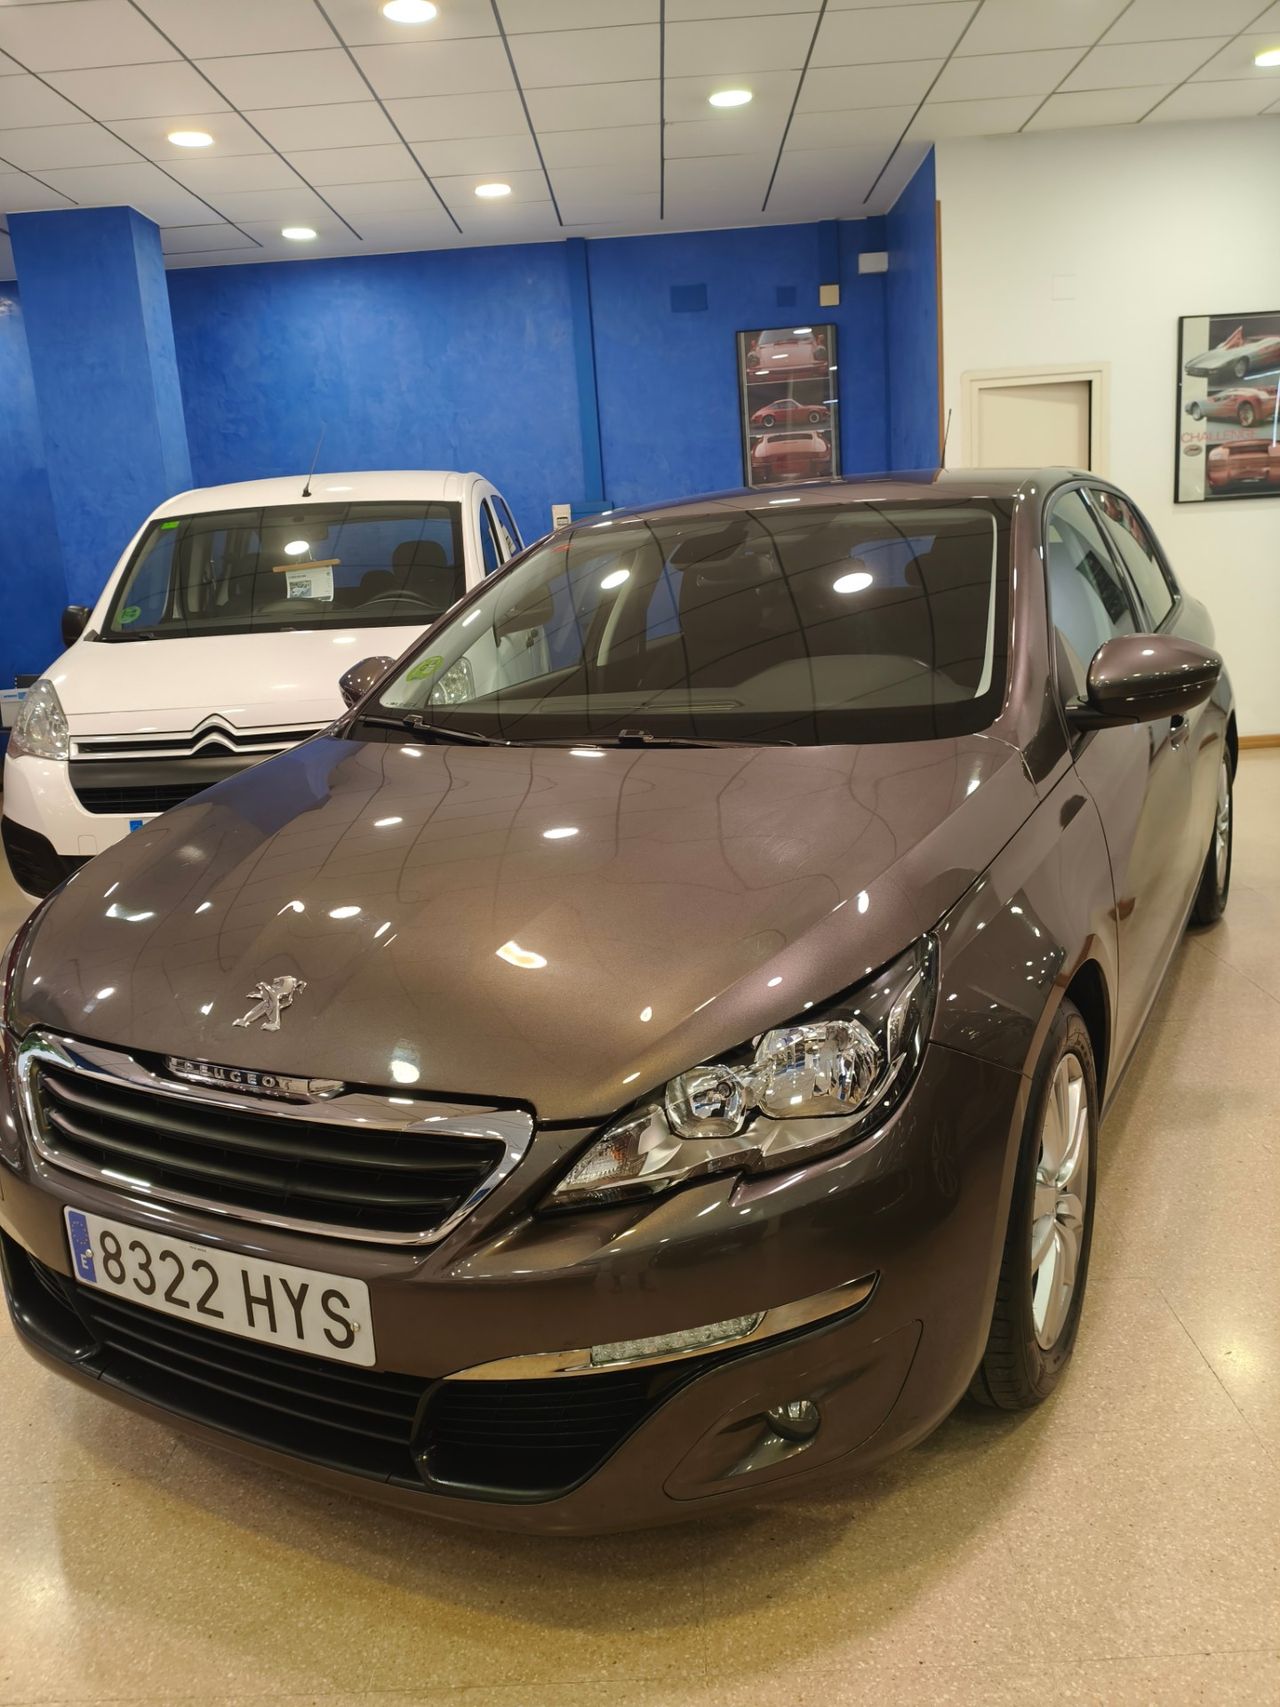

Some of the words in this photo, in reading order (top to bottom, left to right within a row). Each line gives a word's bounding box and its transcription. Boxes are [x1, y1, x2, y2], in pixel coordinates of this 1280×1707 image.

[183, 1061, 292, 1090] PEUGEOT
[80, 1253, 90, 1270] E
[99, 1230, 224, 1319] 8322
[240, 1269, 355, 1350] HYS
